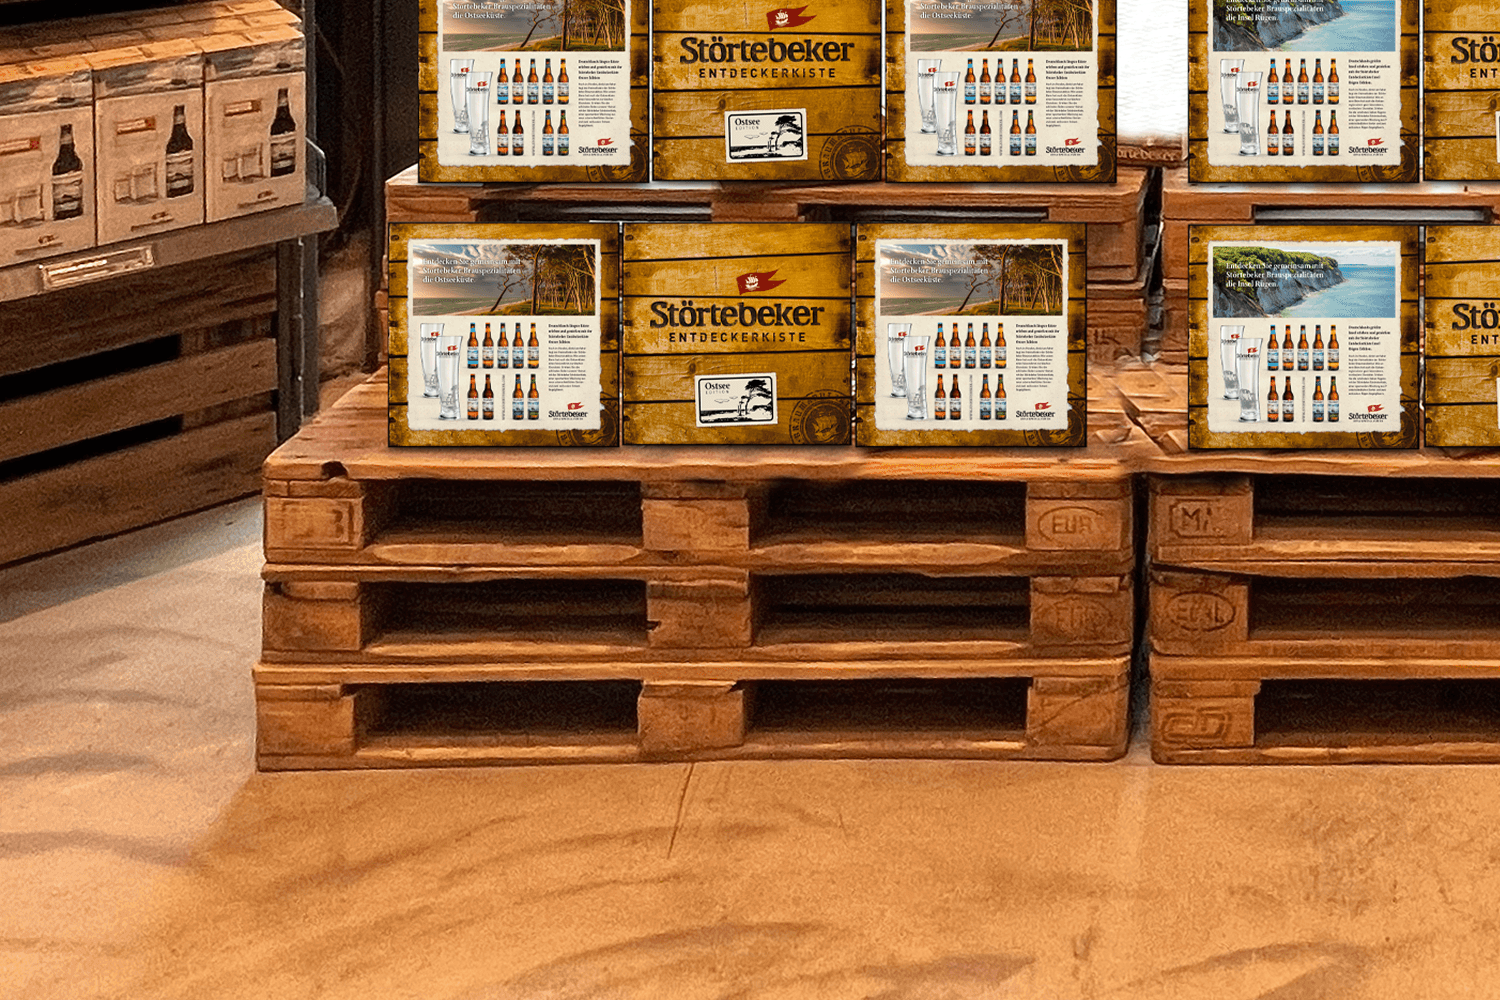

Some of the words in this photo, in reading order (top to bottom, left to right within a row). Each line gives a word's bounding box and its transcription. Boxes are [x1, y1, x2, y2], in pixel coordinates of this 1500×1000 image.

[680, 36, 855, 64] Störtebeker
[699, 68, 836, 79] ENTDECKERKISTE
[734, 118, 761, 126] Ostsee
[650, 300, 825, 328] Störtebeker
[669, 332, 806, 343] ENTDECKERKISTE
[704, 382, 731, 390] Ostsee
